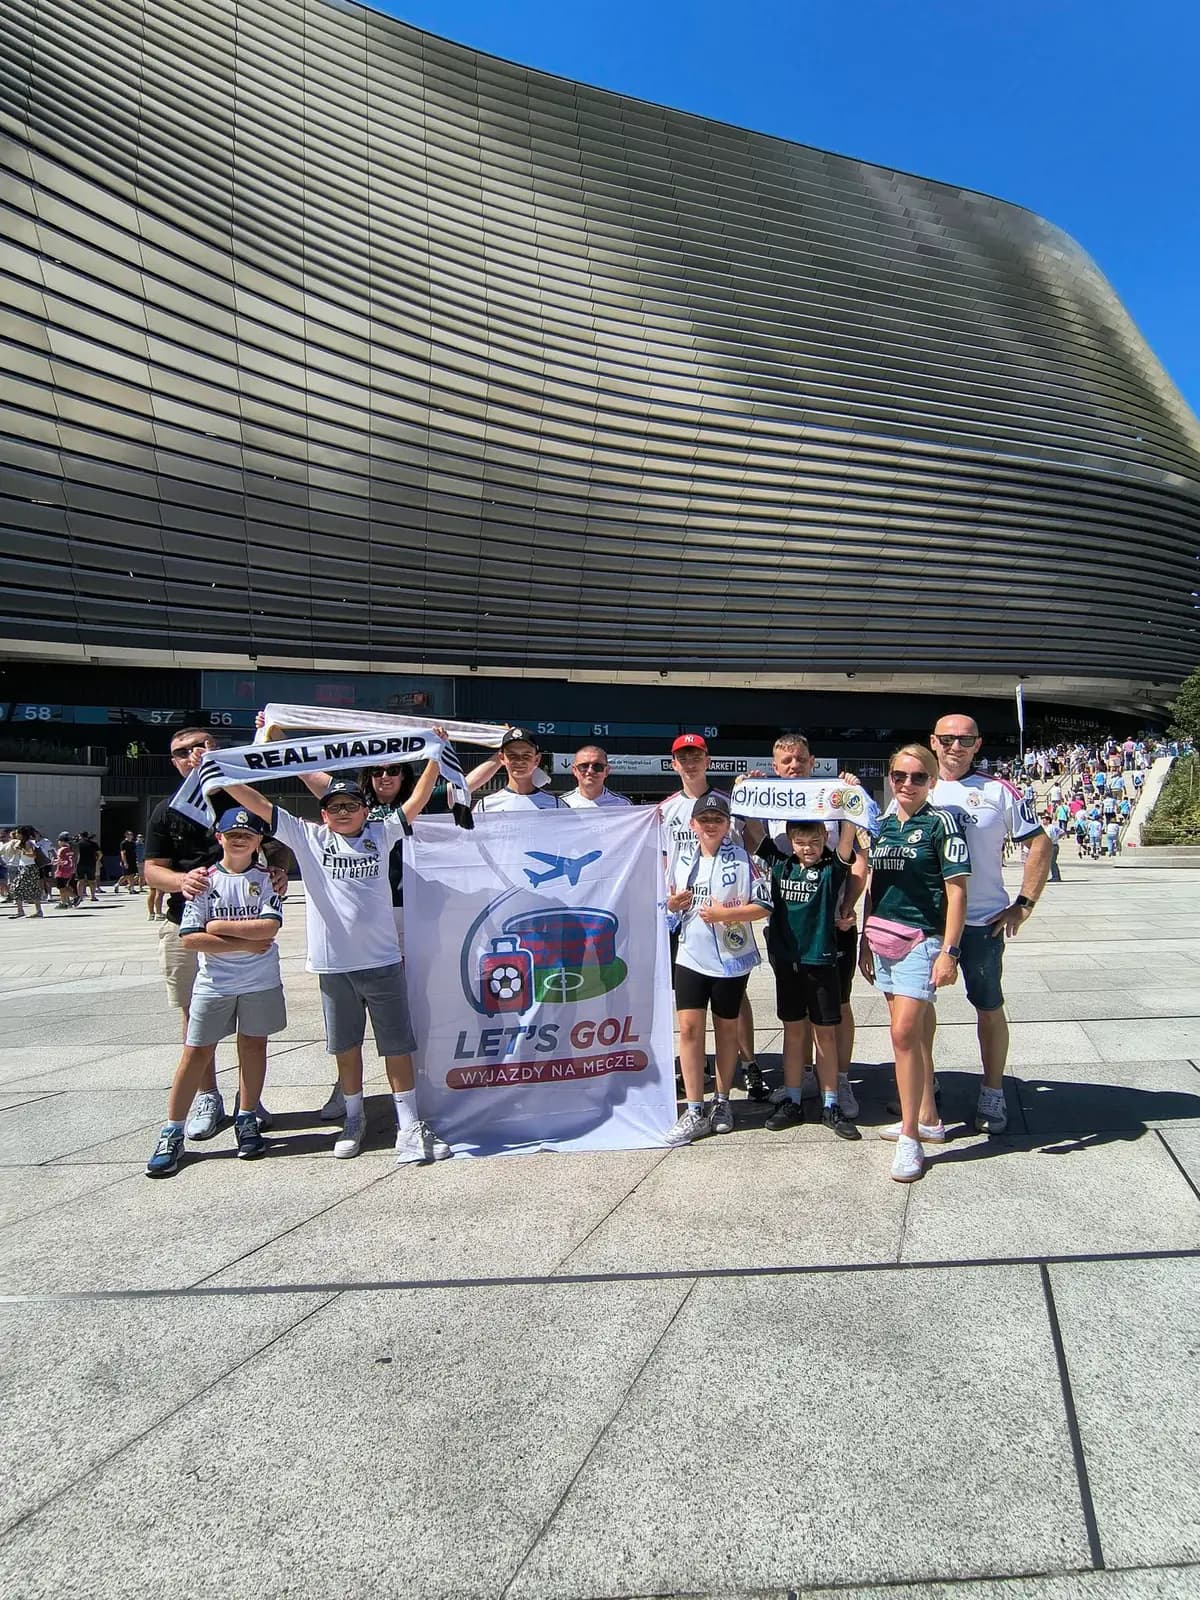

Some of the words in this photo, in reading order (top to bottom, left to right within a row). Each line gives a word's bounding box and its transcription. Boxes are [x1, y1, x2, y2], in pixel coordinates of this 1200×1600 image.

[25, 706, 51, 720] 58
[150, 711, 175, 724] 57
[210, 712, 232, 725] 56
[537, 723, 555, 734] 52
[593, 724, 609, 736] 51
[704, 727, 718, 737] 50
[244, 747, 318, 770] REAL
[324, 736, 426, 761] MADRID
[950, 837, 965, 863] hp
[323, 854, 380, 868] Emirate
[333, 868, 346, 880] FLY
[349, 865, 379, 879] BETTER
[785, 890, 810, 902] BETTER
[210, 904, 260, 918] Emirate
[454, 1023, 560, 1060] LET'S
[570, 1015, 641, 1050] GOL
[460, 1066, 545, 1085] WYJAZDY
[551, 1064, 576, 1077] NA
[583, 1055, 635, 1074] MECZE
